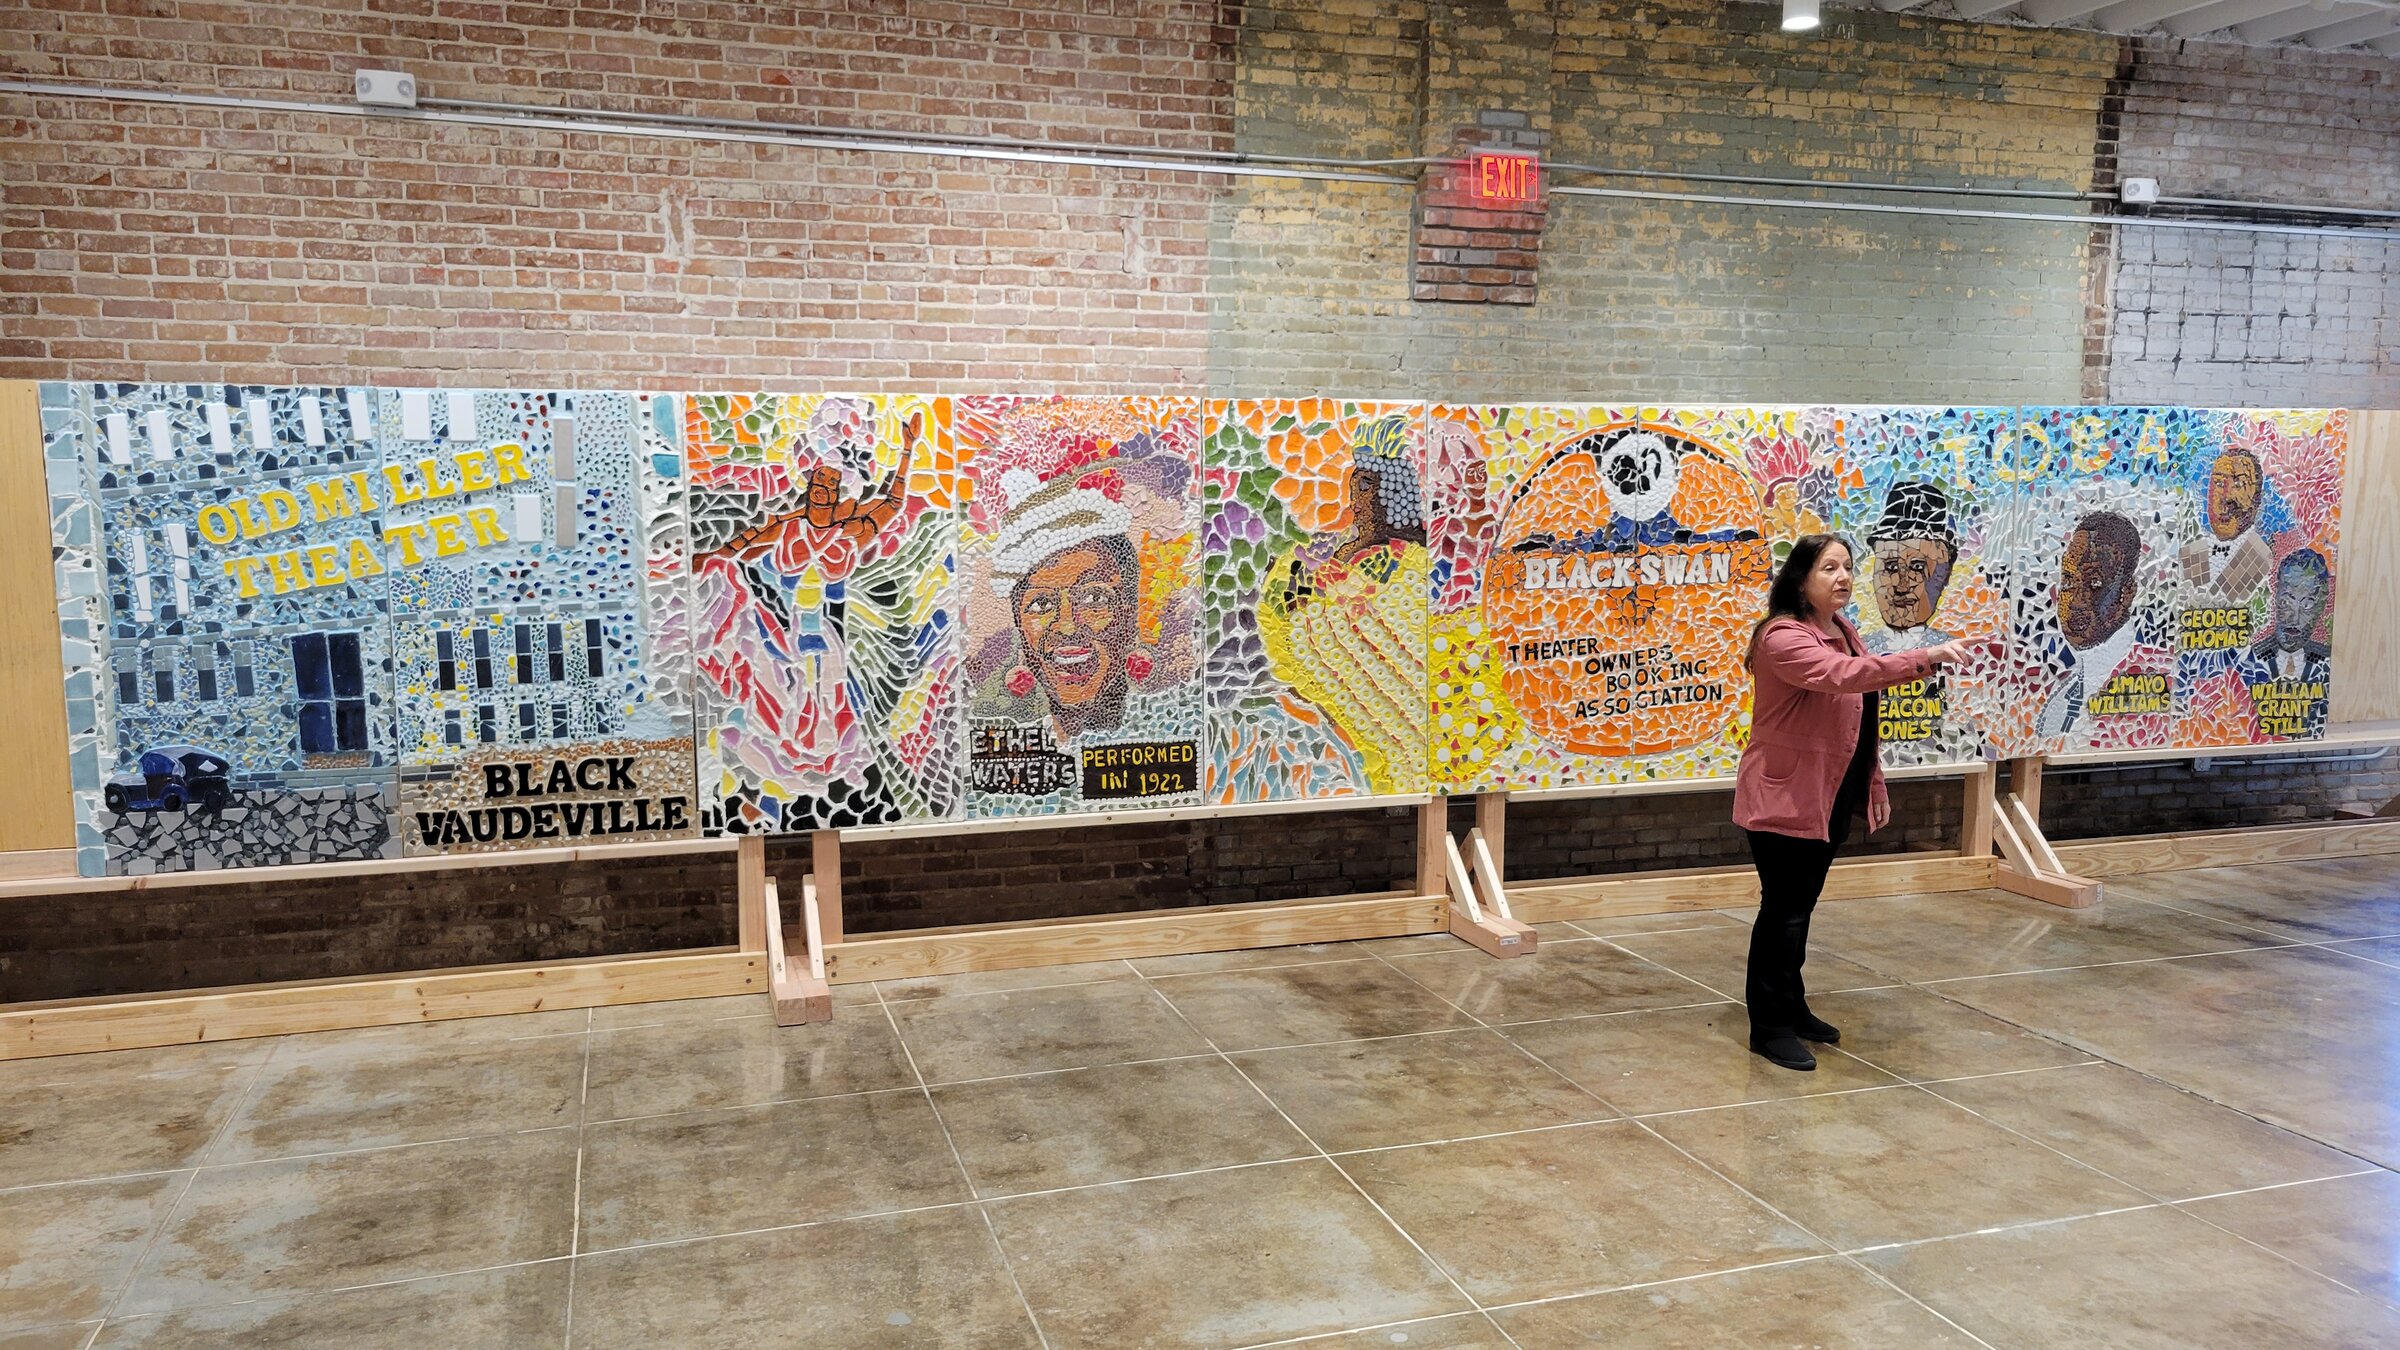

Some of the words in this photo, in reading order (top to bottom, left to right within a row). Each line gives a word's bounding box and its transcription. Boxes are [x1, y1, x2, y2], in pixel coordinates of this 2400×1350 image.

[1482, 156, 1530, 199] EXIT
[197, 489, 301, 545] OLD
[305, 443, 532, 523] MILLER
[223, 506, 510, 599] THEATER
[1523, 557, 1636, 589] BLACK
[1639, 554, 1731, 585] SWAN
[2180, 608, 2249, 628] GEORGE
[1508, 637, 1600, 663] THEATER
[2180, 629, 2249, 649] THOMAS
[1585, 644, 1674, 675] OWNERS
[1575, 683, 1723, 718] ASSOCIATION
[2088, 692, 2171, 714] WILLIAMS
[2251, 681, 2325, 700] WILLIAM
[2257, 699, 2312, 718] GRANT
[1879, 719, 1932, 740] ONES
[2259, 717, 2309, 736] STILL
[971, 728, 1057, 753] ETHEL
[1083, 744, 1194, 768] PERFORMED
[483, 756, 637, 799] BLACK
[972, 761, 1077, 786] WATERS
[1101, 769, 1129, 790] IN
[1139, 772, 1185, 795] 1922
[415, 796, 690, 847] VAUDEVILLE
